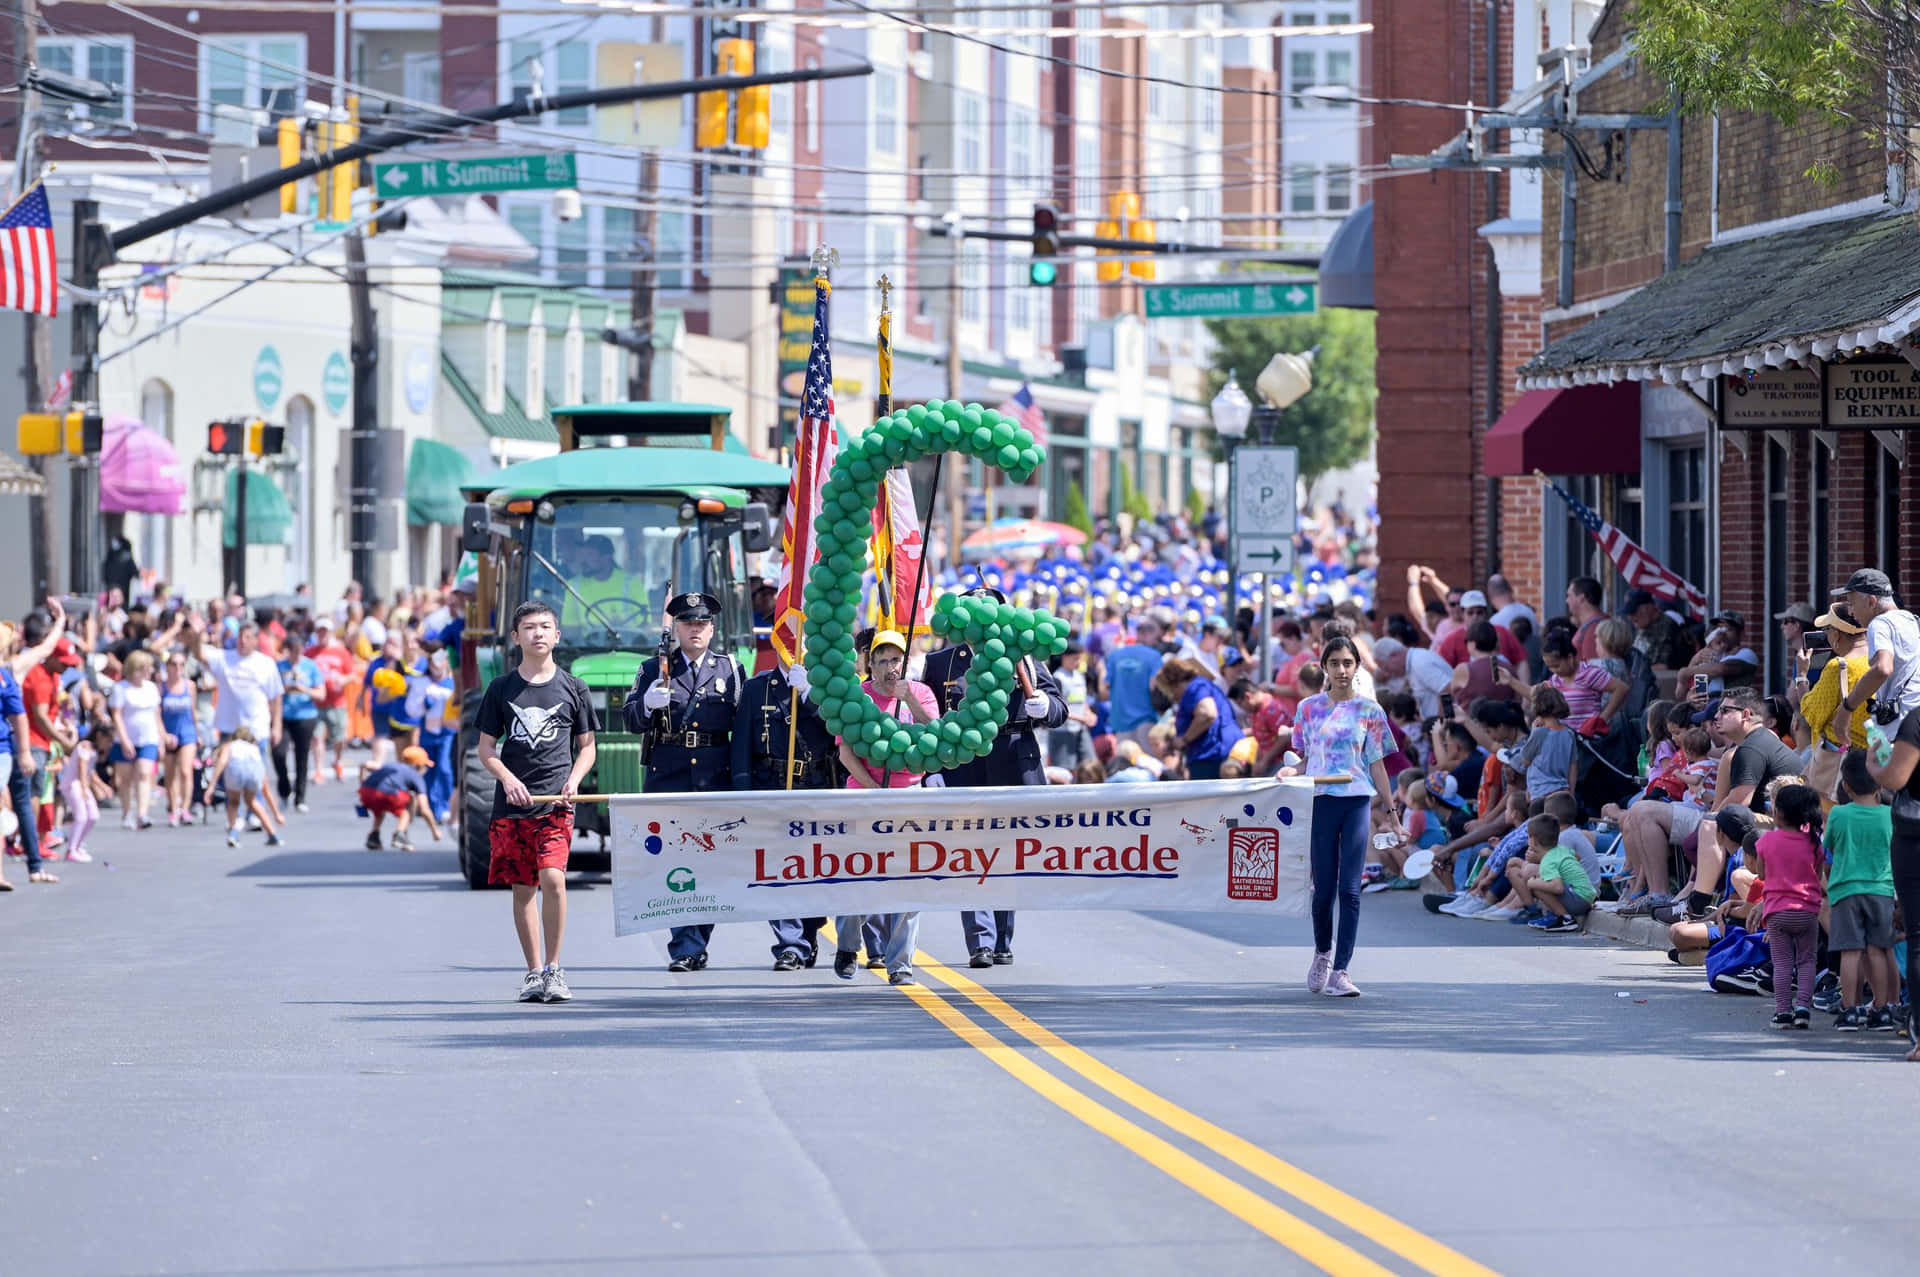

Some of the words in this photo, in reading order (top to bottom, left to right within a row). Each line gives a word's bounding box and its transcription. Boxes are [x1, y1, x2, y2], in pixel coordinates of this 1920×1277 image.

[422, 164, 438, 187] N
[447, 159, 528, 186] Summit
[1150, 288, 1163, 312] S
[1169, 288, 1241, 312] Summit
[1850, 369, 1900, 383] TOOL
[1761, 391, 1819, 400] TRACTORS
[1834, 386, 1920, 403] EQUIPME
[1261, 486, 1274, 504] P
[788, 820, 848, 838] 81st
[871, 808, 1151, 834] GAITHERSBURG
[755, 843, 895, 881] Labor
[909, 840, 1000, 885] Day
[1015, 834, 1179, 872] Parade
[647, 894, 716, 909] Gaithersburg
[640, 907, 685, 920] CHARACTER
